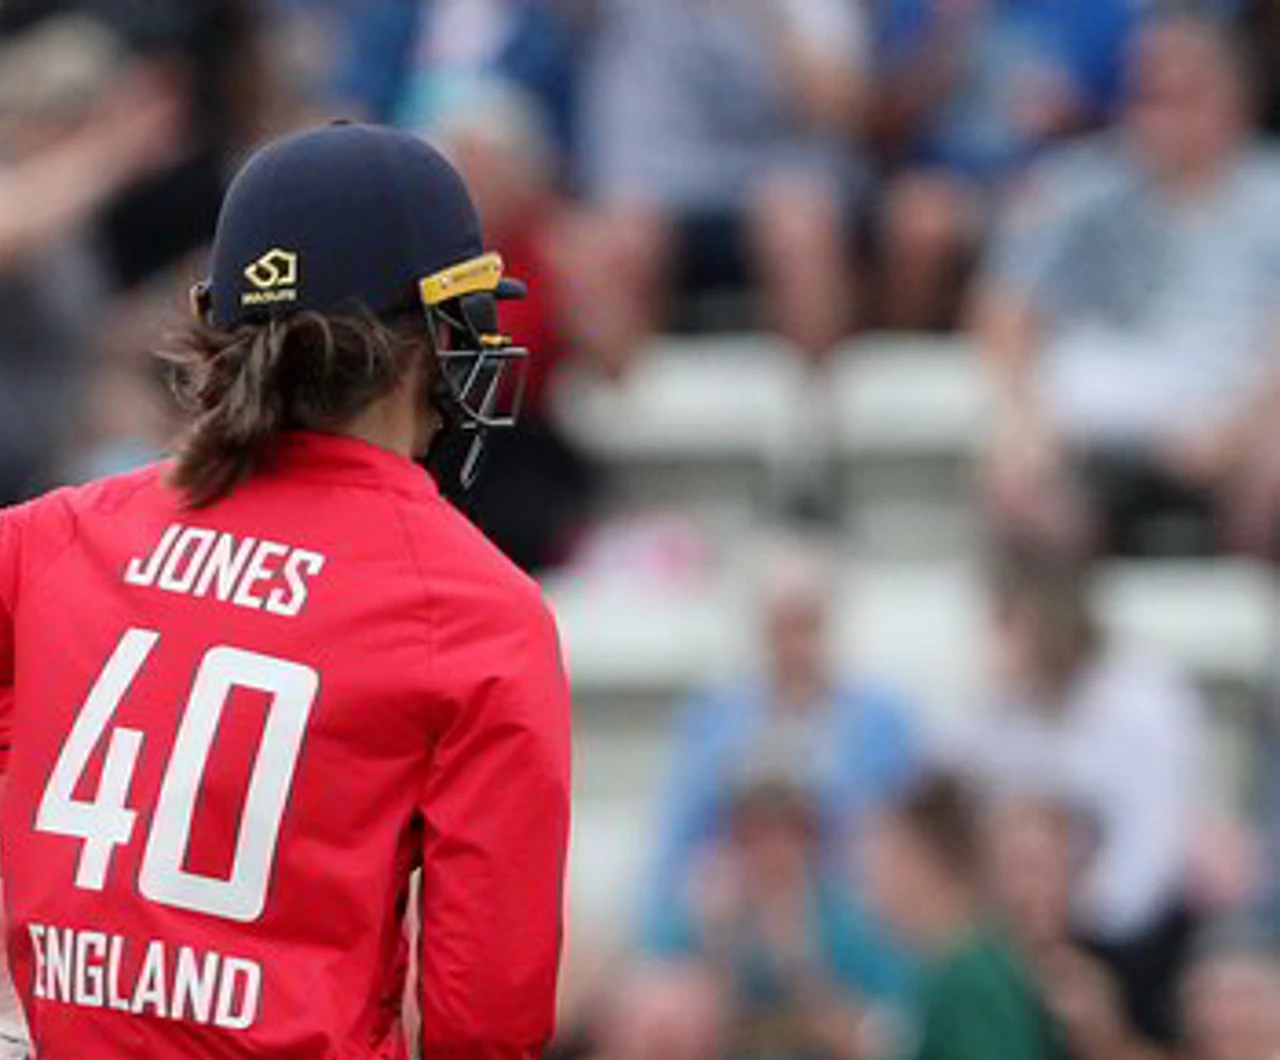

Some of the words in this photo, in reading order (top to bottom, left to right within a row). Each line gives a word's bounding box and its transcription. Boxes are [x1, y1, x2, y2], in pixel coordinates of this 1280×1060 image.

[124, 523, 325, 617] JONES
[34, 627, 320, 922] 40
[26, 922, 263, 1030] ENGLAND
